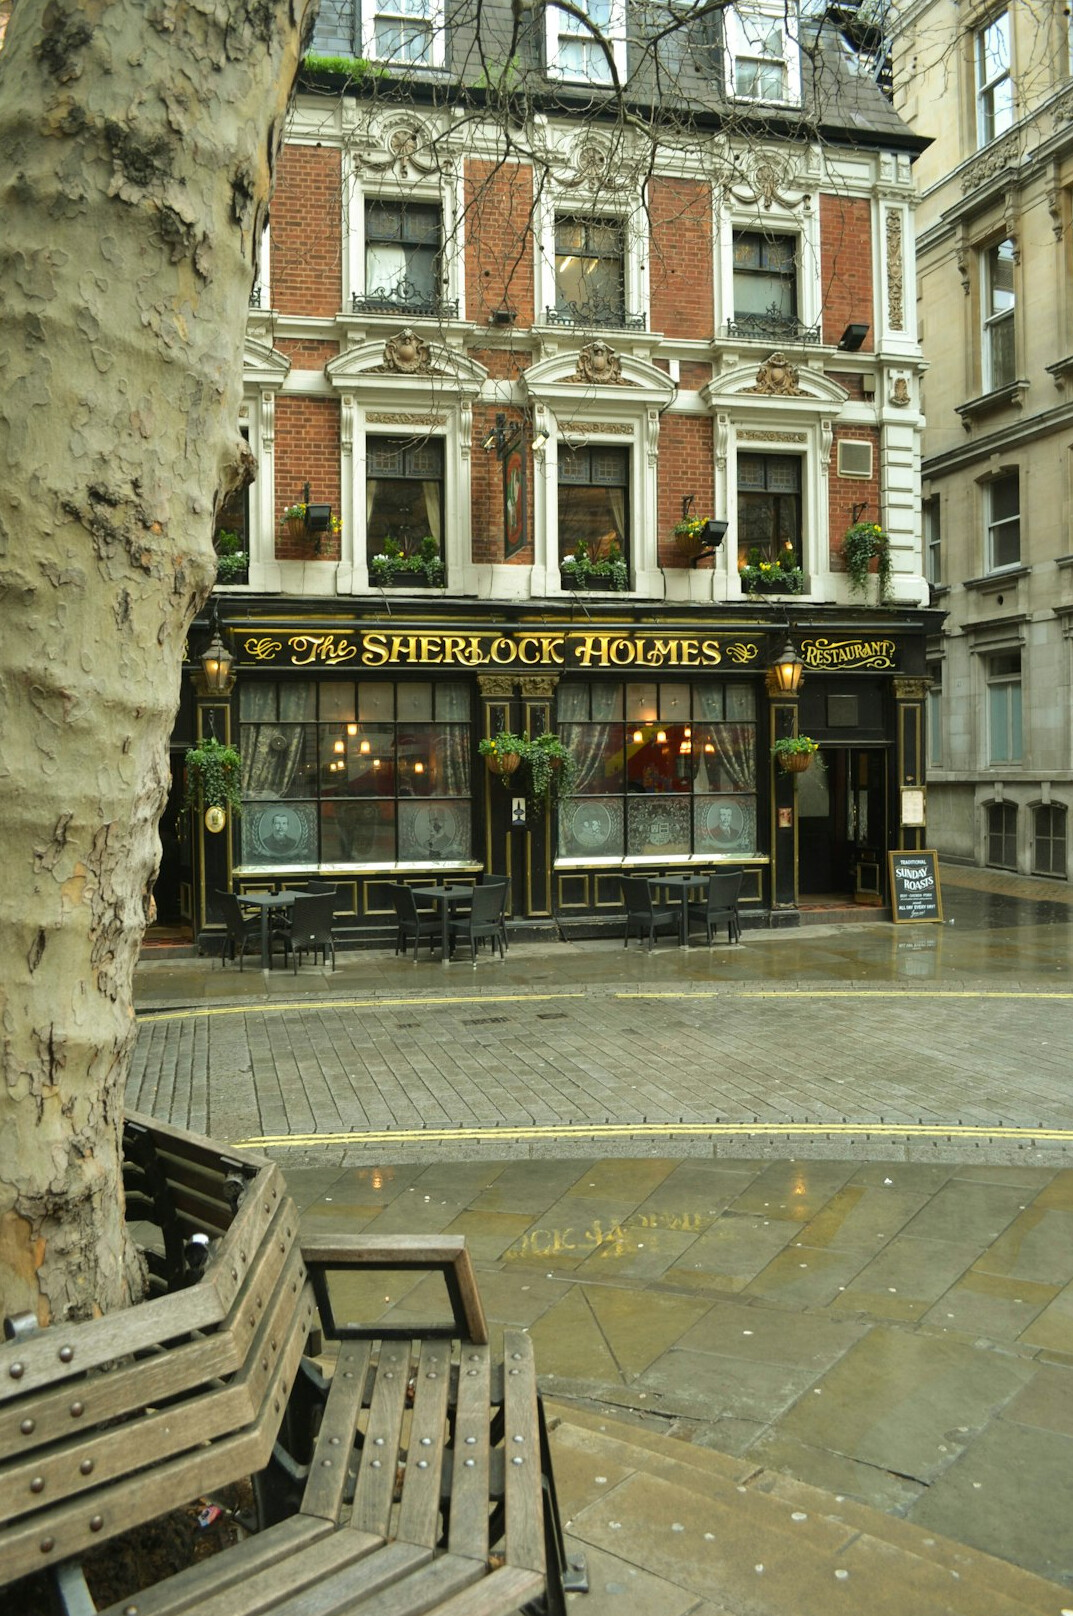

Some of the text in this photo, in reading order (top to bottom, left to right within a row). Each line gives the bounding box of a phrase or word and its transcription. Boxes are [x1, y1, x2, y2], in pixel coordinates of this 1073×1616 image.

[288, 634, 722, 667] The SHERLOCK HOLMES
[805, 641, 890, 666] RESTAURANT
[896, 867, 928, 879] SUNDAY
[904, 876, 934, 890] ROASTS
